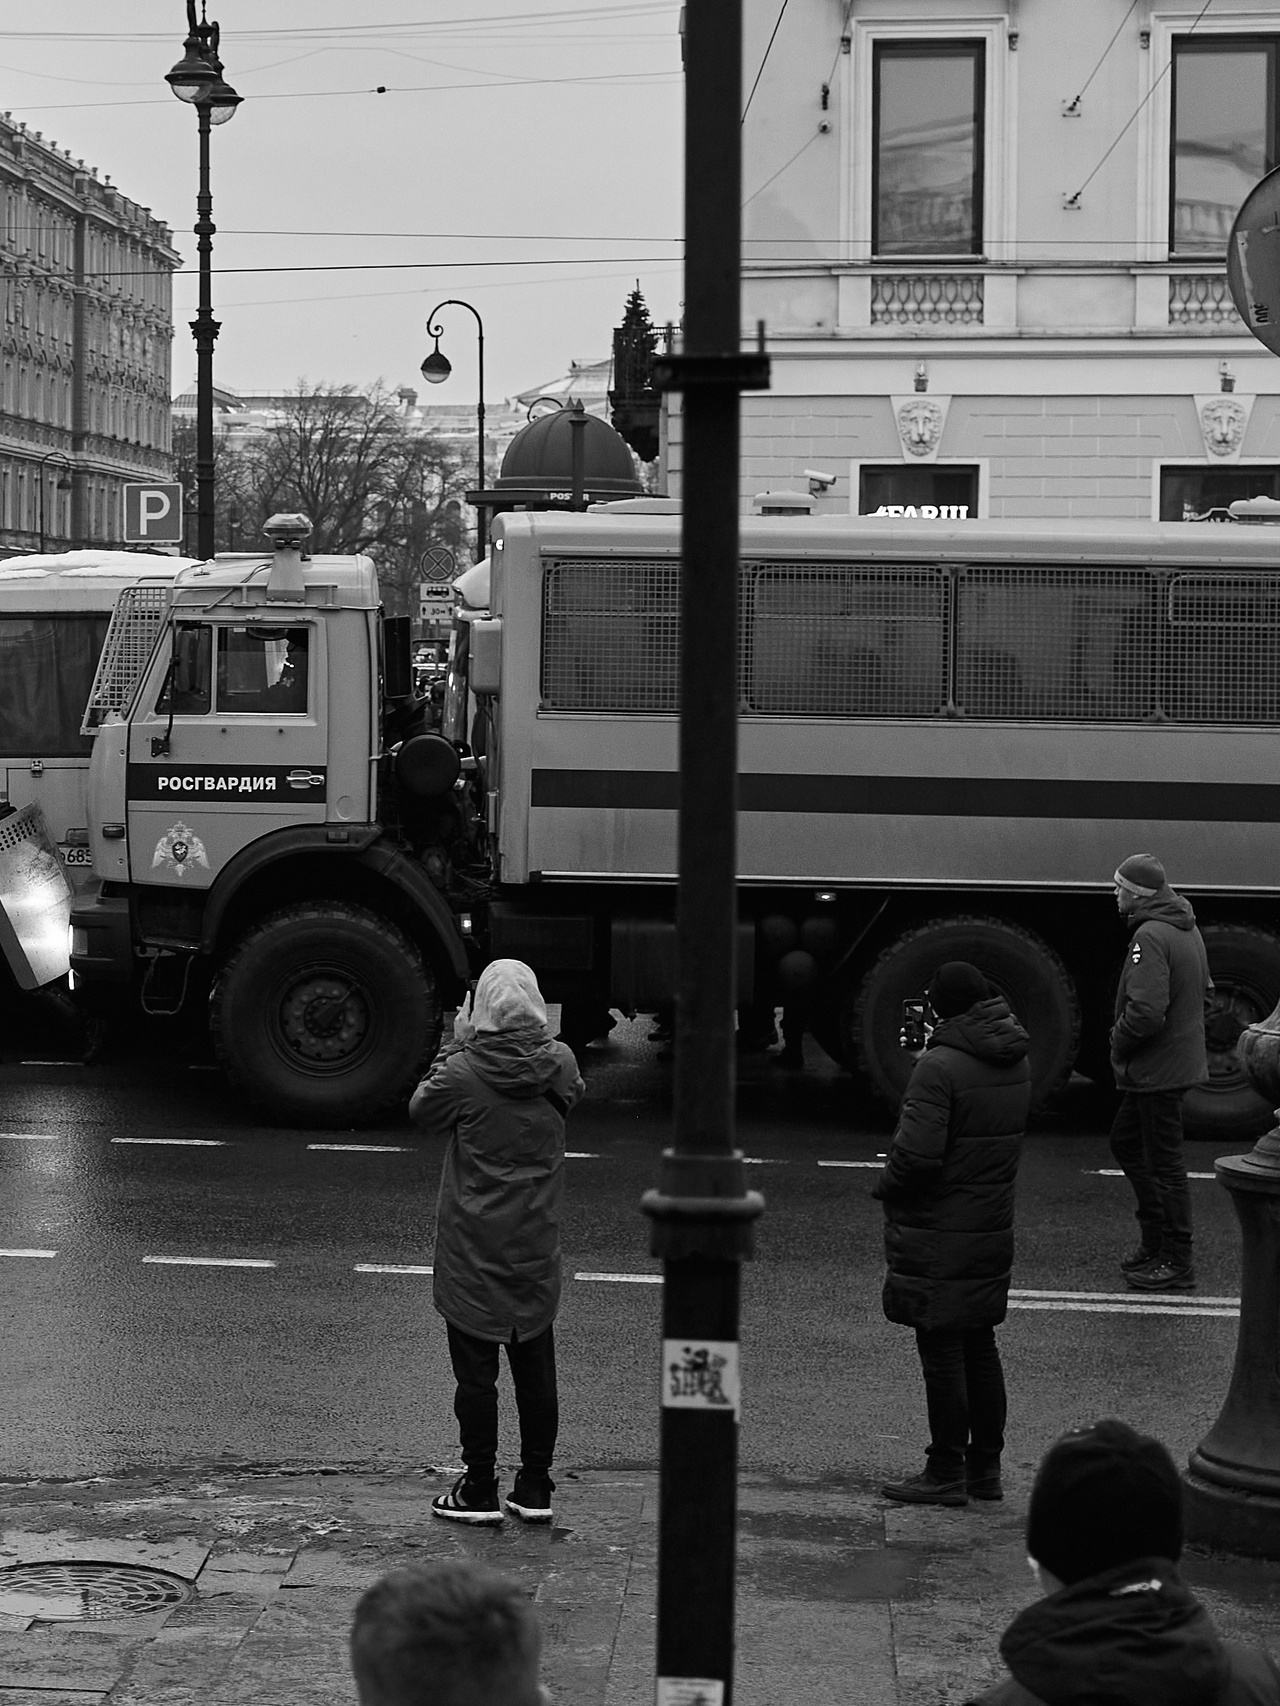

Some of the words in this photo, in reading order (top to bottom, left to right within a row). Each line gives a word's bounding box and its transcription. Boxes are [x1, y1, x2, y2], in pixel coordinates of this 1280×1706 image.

[549, 492, 590, 502] POSR
[140, 490, 170, 535] P
[157, 776, 277, 793] РОСГВАРДИЯ
